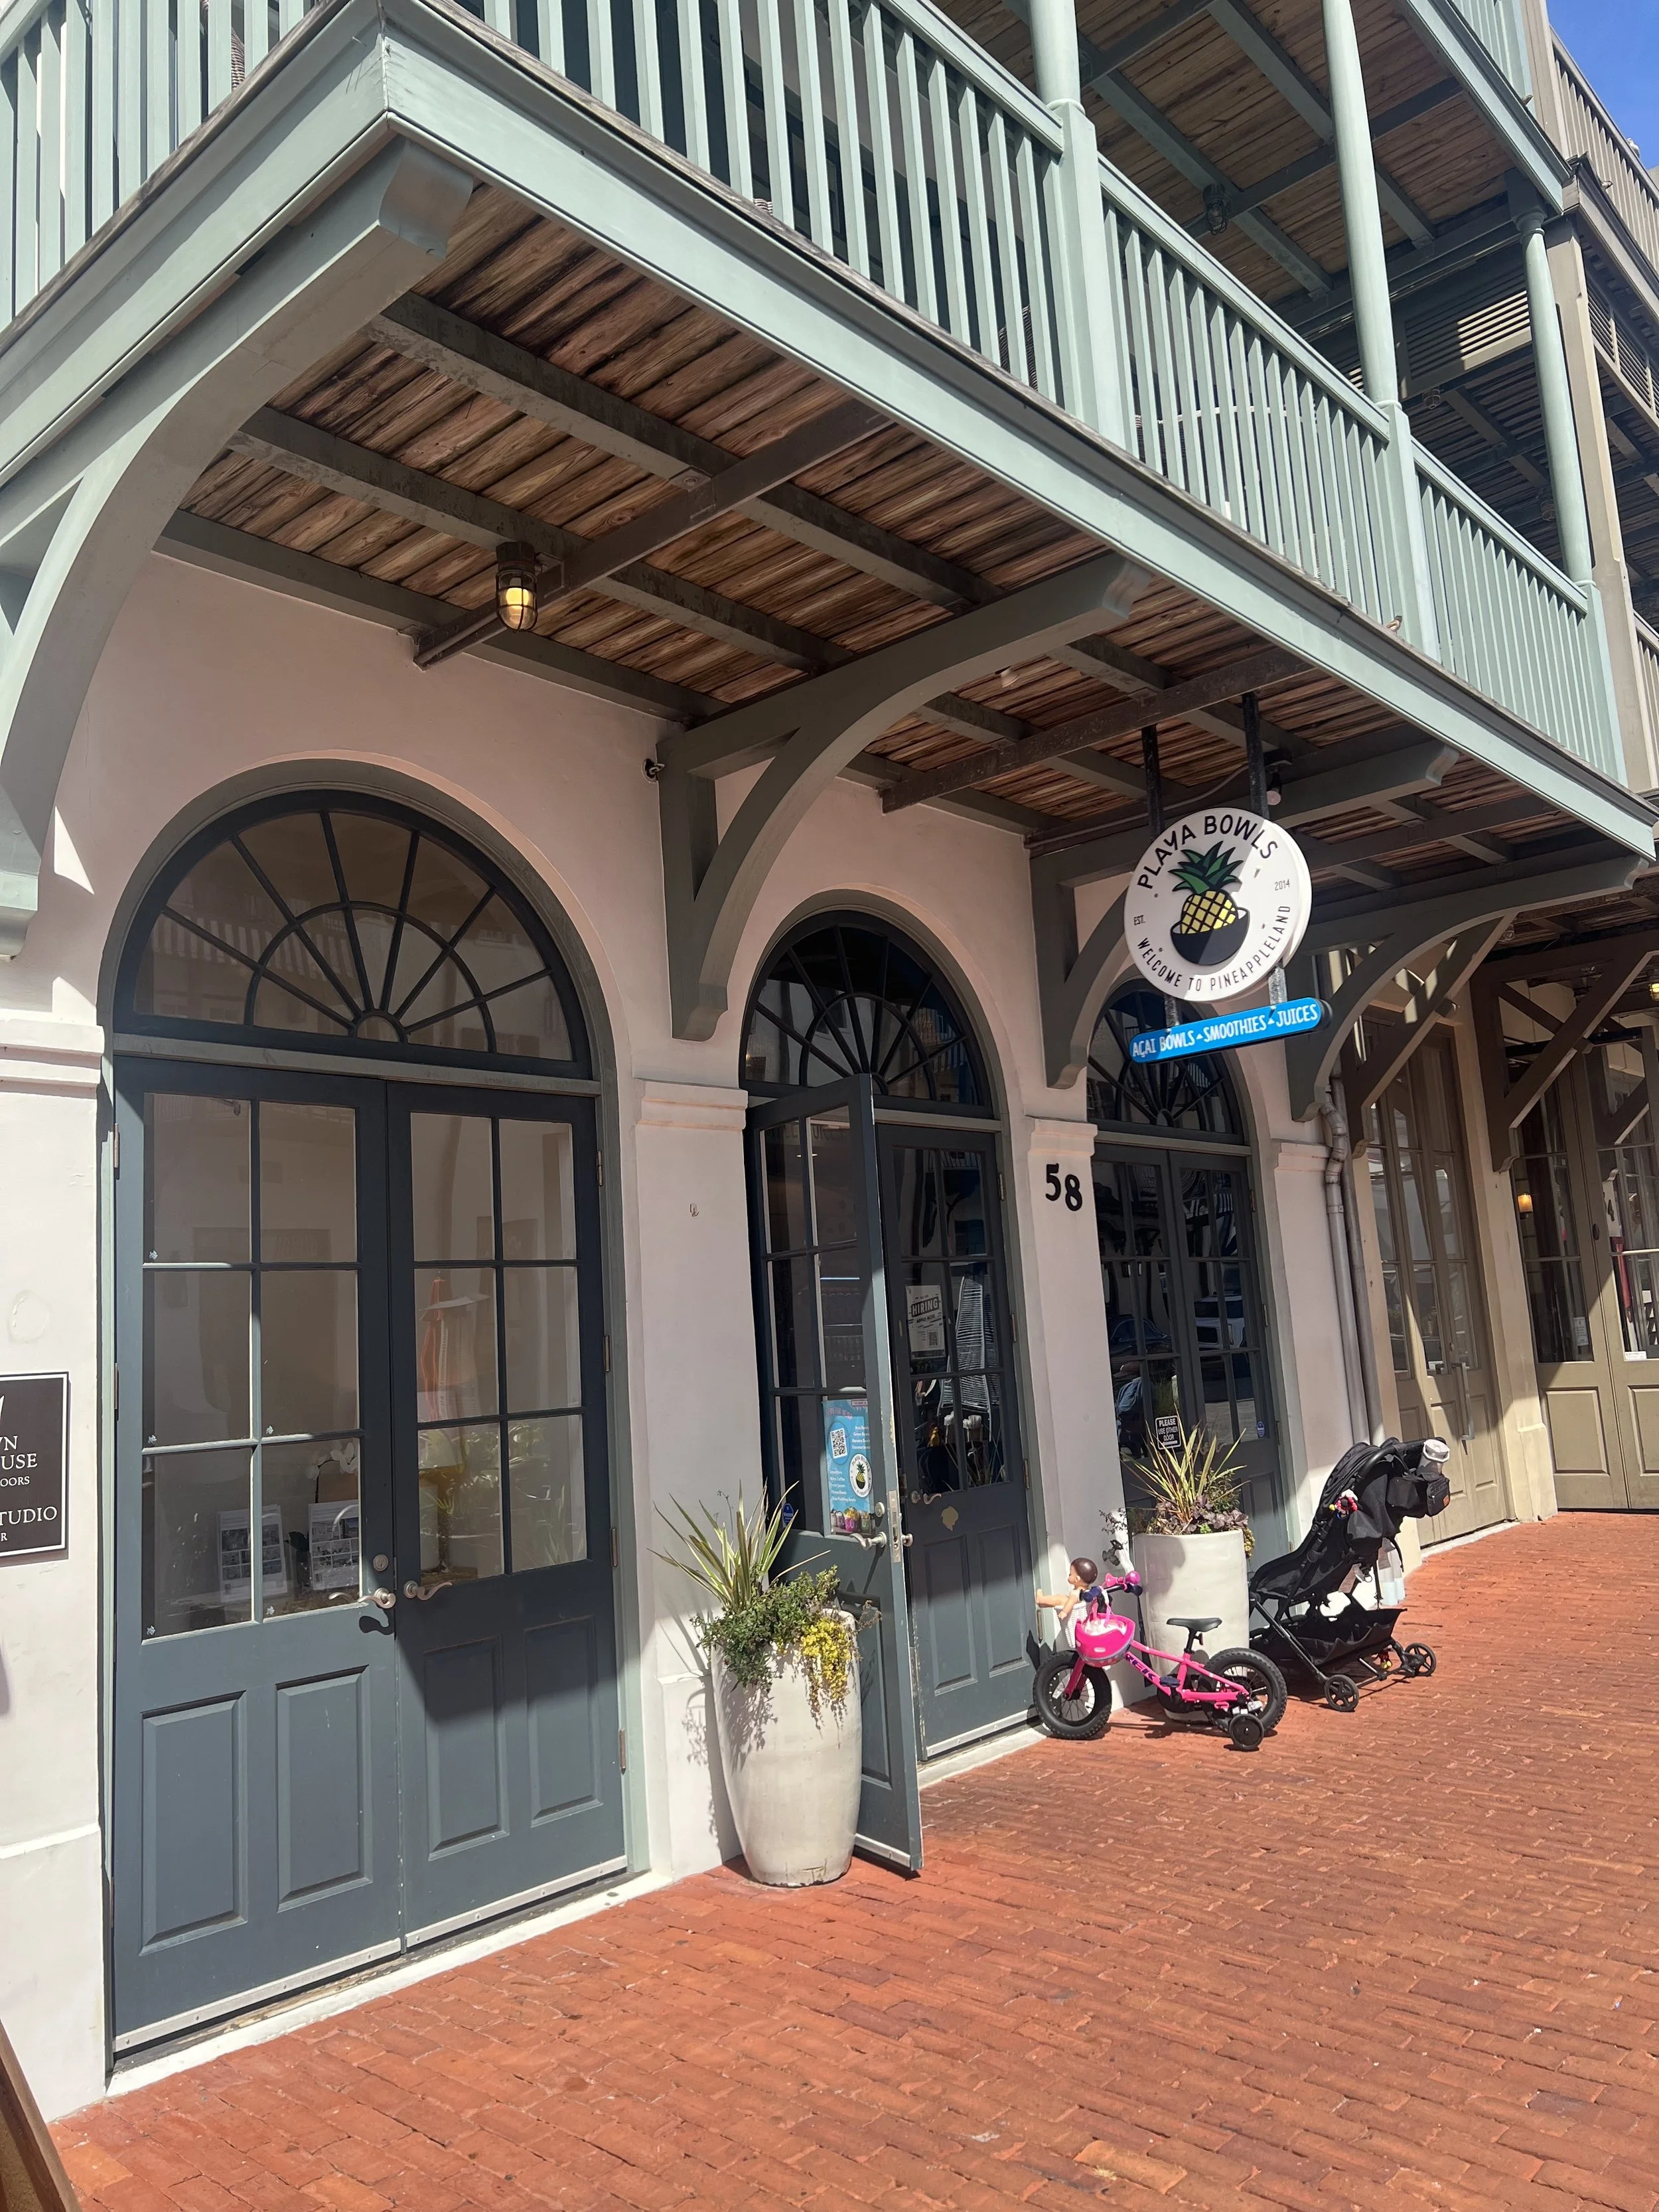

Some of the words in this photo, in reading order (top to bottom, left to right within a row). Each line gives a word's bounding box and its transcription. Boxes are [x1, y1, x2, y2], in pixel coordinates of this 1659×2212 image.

[1137, 824, 1196, 889] PLAYA
[1204, 815, 1279, 859] BOWLS
[1273, 879, 1291, 891] 2014
[1133, 915, 1145, 926] EST.
[1137, 937, 1182, 988] WELCOME
[1188, 977, 1202, 992] TO
[1210, 905, 1291, 991] PINEAPPLELAND
[1160, 1030, 1194, 1051] BOWLS
[1203, 1015, 1266, 1041] SMOOTHIES
[1275, 1004, 1318, 1027] JUICES
[1045, 1163, 1083, 1212] 58
[912, 1299, 938, 1315] HIRING
[1159, 1418, 1176, 1427] PLEASE
